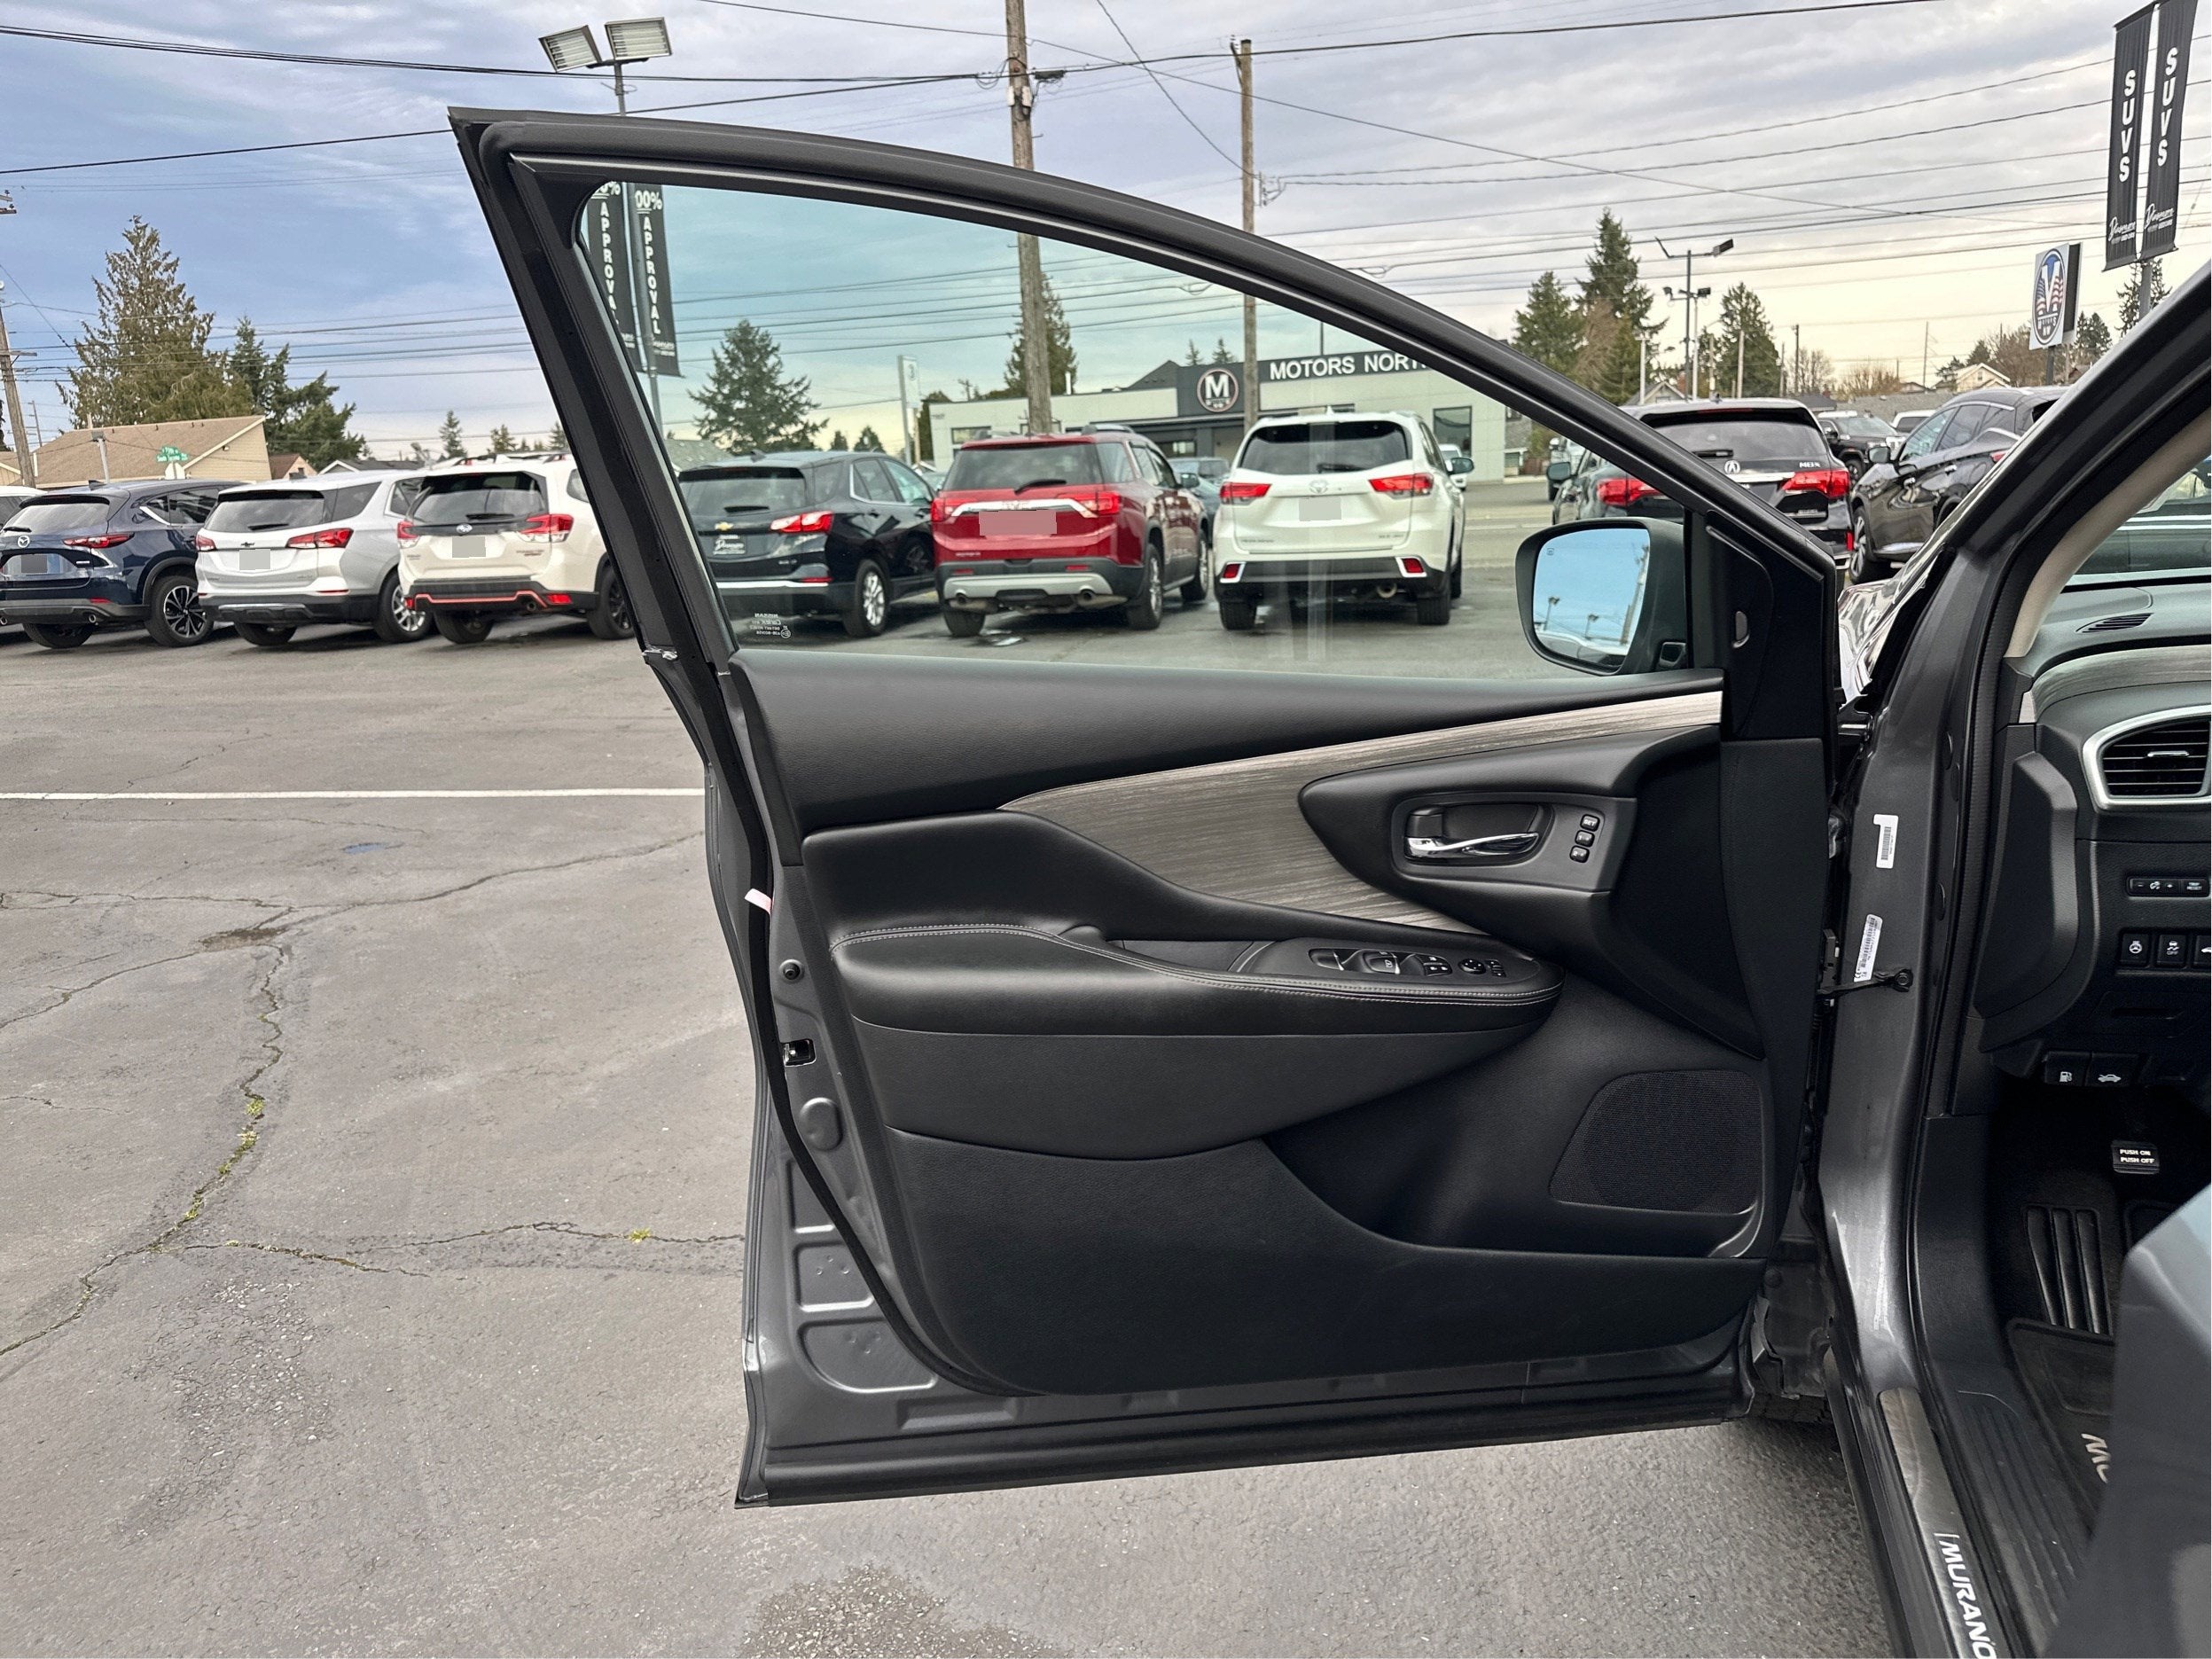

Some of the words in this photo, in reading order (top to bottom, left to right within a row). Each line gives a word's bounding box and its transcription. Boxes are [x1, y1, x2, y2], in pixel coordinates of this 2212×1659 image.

[2119, 69, 2137, 183] SUVS
[2157, 47, 2178, 167] SUVS
[634, 190, 663, 210] 00%
[600, 201, 619, 325] APPROVA
[643, 216, 661, 334] APPROVAL
[1205, 373, 1230, 398] M
[1270, 356, 1356, 380] MOTORS
[1364, 353, 1426, 372] NORT
[1938, 1540, 1997, 1659] MURANO
